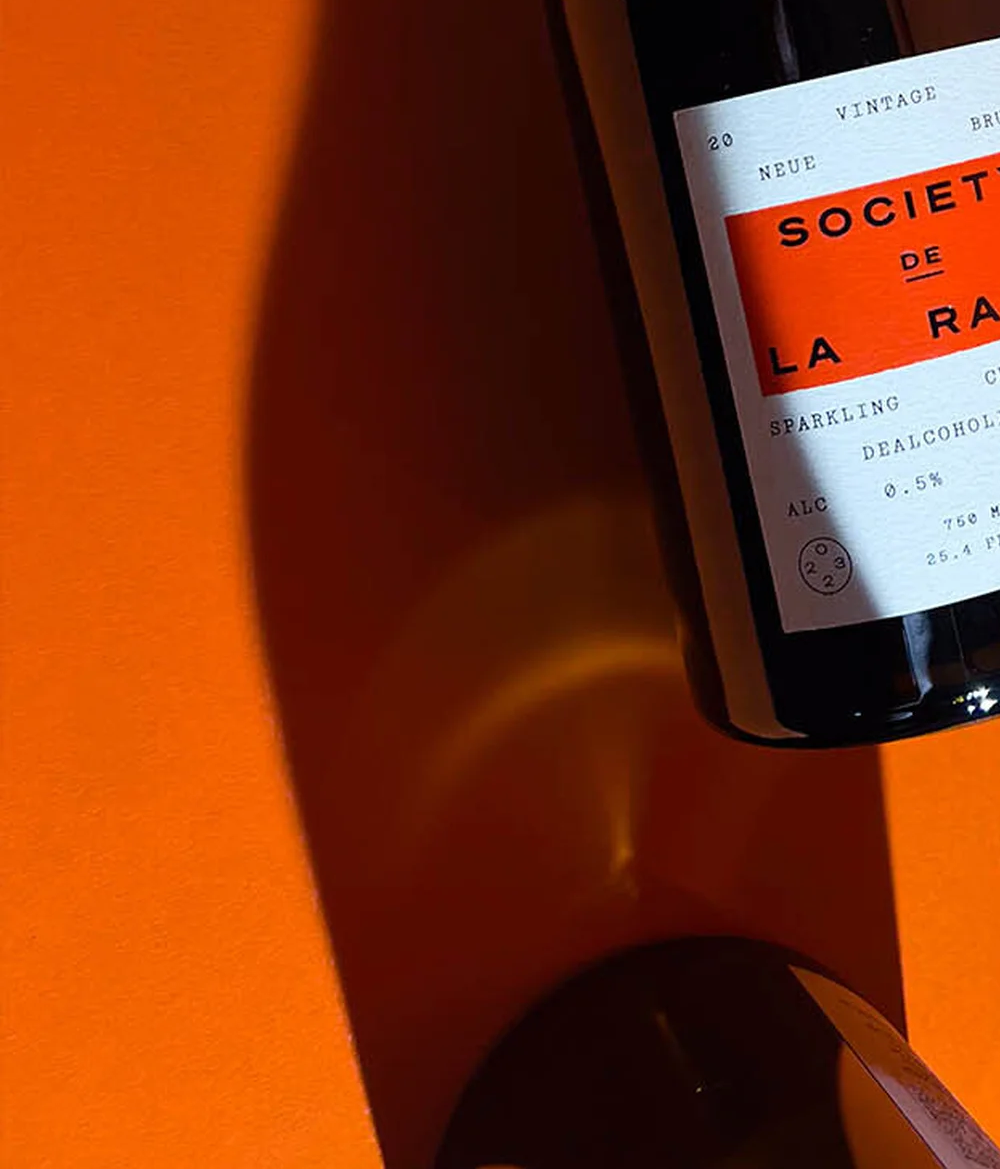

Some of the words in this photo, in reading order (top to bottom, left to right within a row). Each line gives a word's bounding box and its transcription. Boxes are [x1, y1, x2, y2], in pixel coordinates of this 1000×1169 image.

[707, 132, 734, 151] 20
[836, 86, 938, 122] VINTAGE
[758, 155, 817, 181] NEUE
[900, 245, 944, 271] DE
[768, 336, 842, 376] LA
[769, 395, 900, 438] SPARKLING
[787, 496, 829, 518] ALC
[884, 470, 944, 499] 0.5%
[943, 512, 979, 531] 750
[926, 543, 973, 567] 25.4
